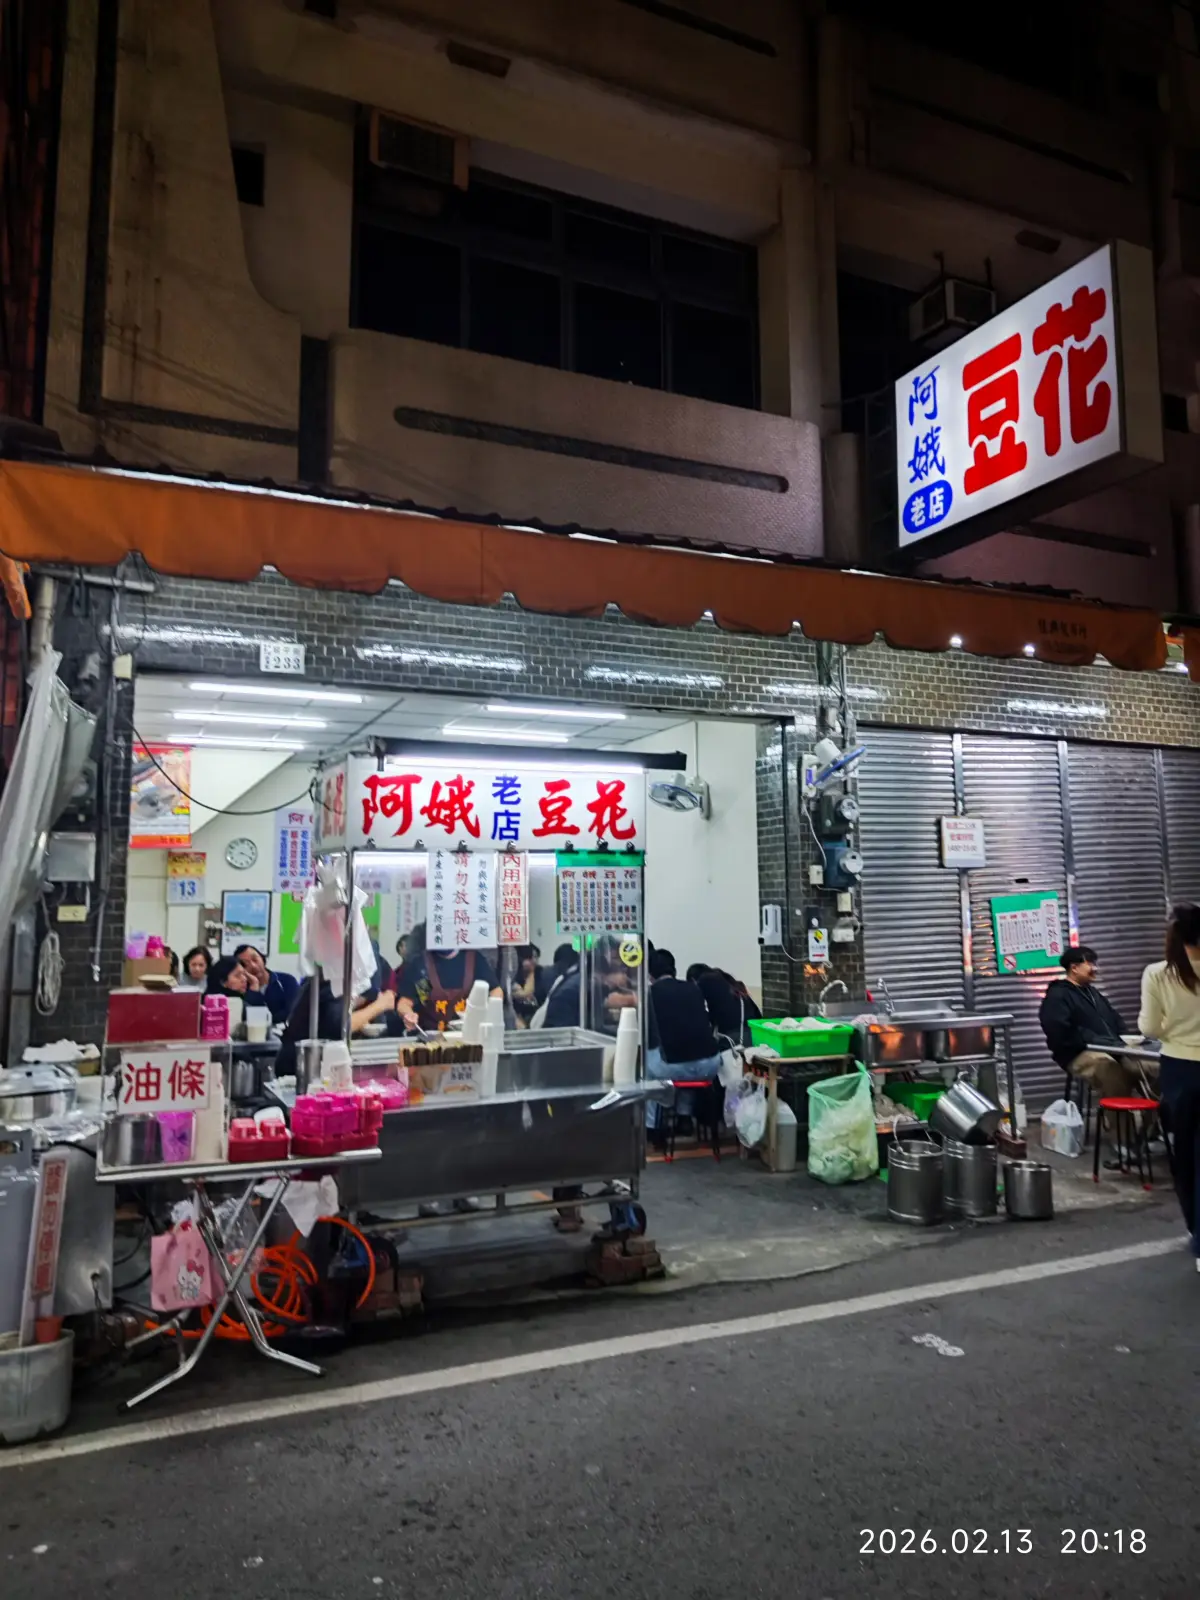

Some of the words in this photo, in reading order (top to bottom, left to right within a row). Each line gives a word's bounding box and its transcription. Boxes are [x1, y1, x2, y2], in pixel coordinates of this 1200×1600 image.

[963, 285, 1112, 496] 豆花
[908, 365, 946, 483] 阿娥
[910, 487, 946, 527] 老店
[362, 773, 481, 839] 阿娥
[491, 775, 522, 842] 老店
[532, 779, 637, 841] 豆花
[179, 880, 197, 897] 13
[123, 1058, 206, 1104] 油條
